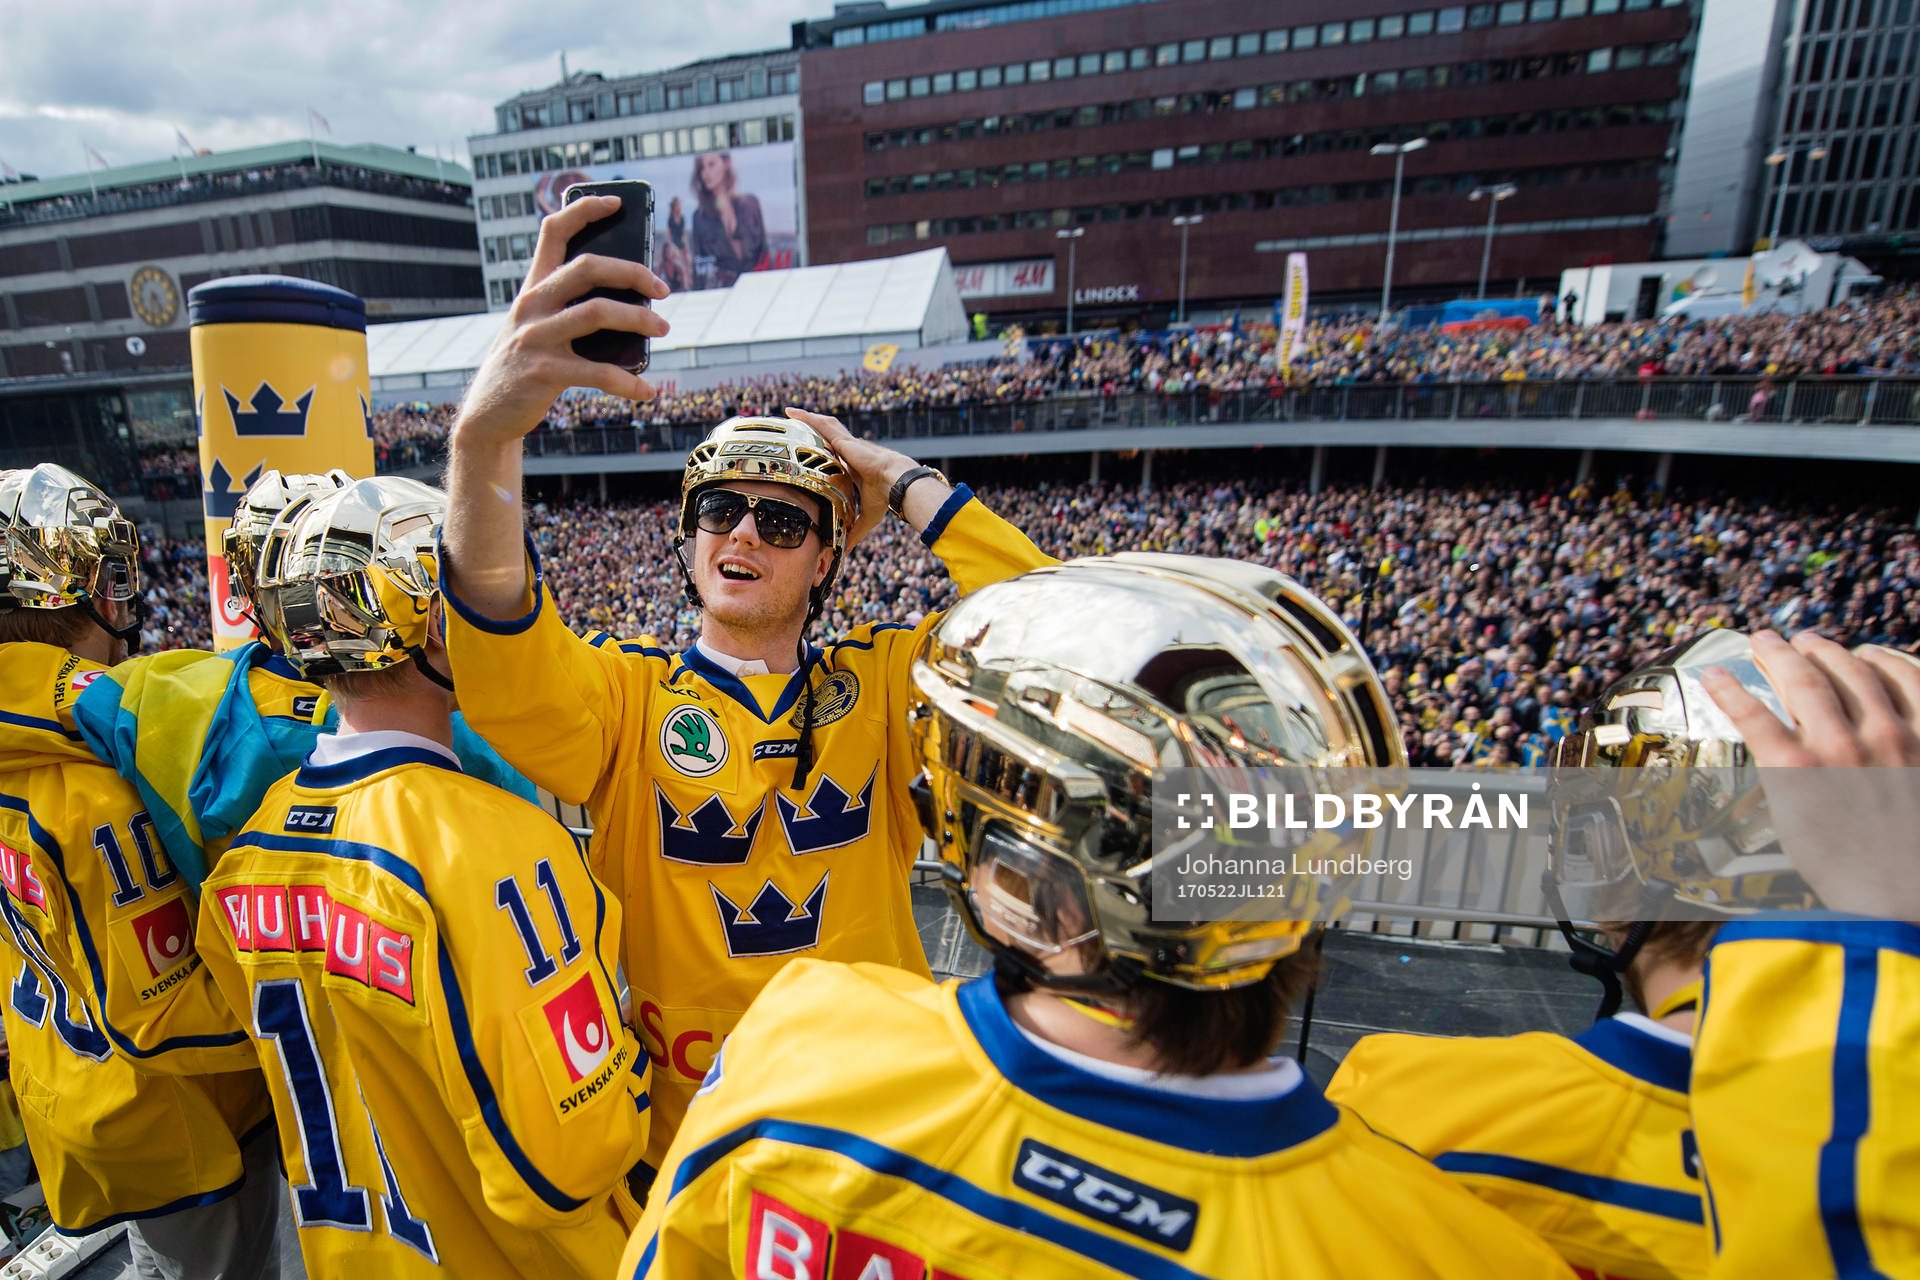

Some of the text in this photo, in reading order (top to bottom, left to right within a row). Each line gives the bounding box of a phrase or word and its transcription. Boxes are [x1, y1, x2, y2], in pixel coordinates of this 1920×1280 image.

[1075, 286, 1138, 303] LINDEX
[725, 443, 784, 455] CCM
[54, 682, 66, 707] SPEL
[753, 743, 798, 758] CCM
[92, 809, 179, 909] 10
[224, 894, 406, 987] AUHUS
[494, 857, 583, 987] 11
[141, 967, 190, 1001] SVENSKA
[559, 1045, 628, 1115] SVENSKA SPE
[1021, 1149, 1192, 1238] CCM
